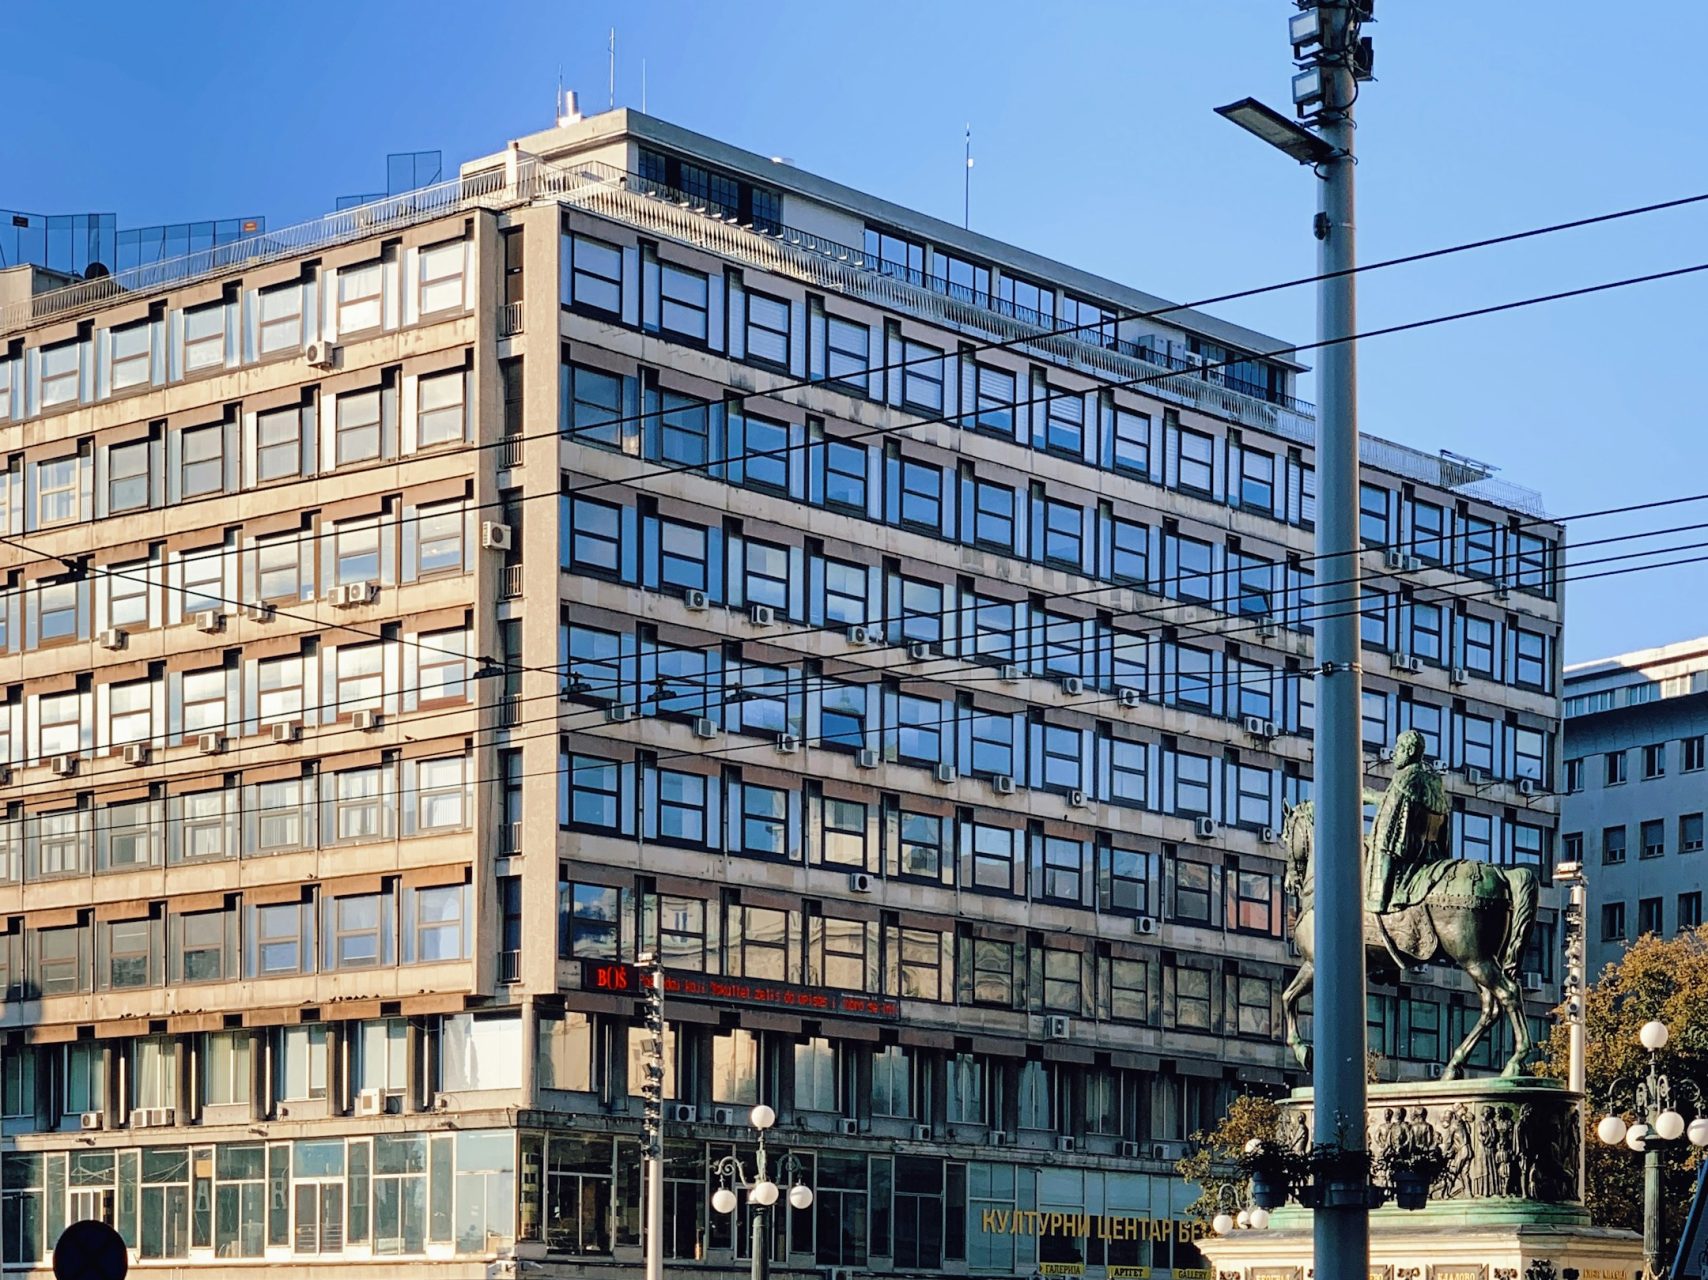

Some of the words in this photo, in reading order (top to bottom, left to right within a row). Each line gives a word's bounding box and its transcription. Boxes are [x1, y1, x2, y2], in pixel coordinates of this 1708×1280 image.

[982, 1208, 1090, 1238] КУЛТУРНИ
[1097, 1215, 1173, 1244] ЦЕНТАР
[1178, 1219, 1202, 1243] БЕ
[1045, 1264, 1081, 1275] ГАЛЕРИЈА
[1114, 1268, 1144, 1278] АРТГЕТ
[1178, 1270, 1207, 1280] GALLERY
